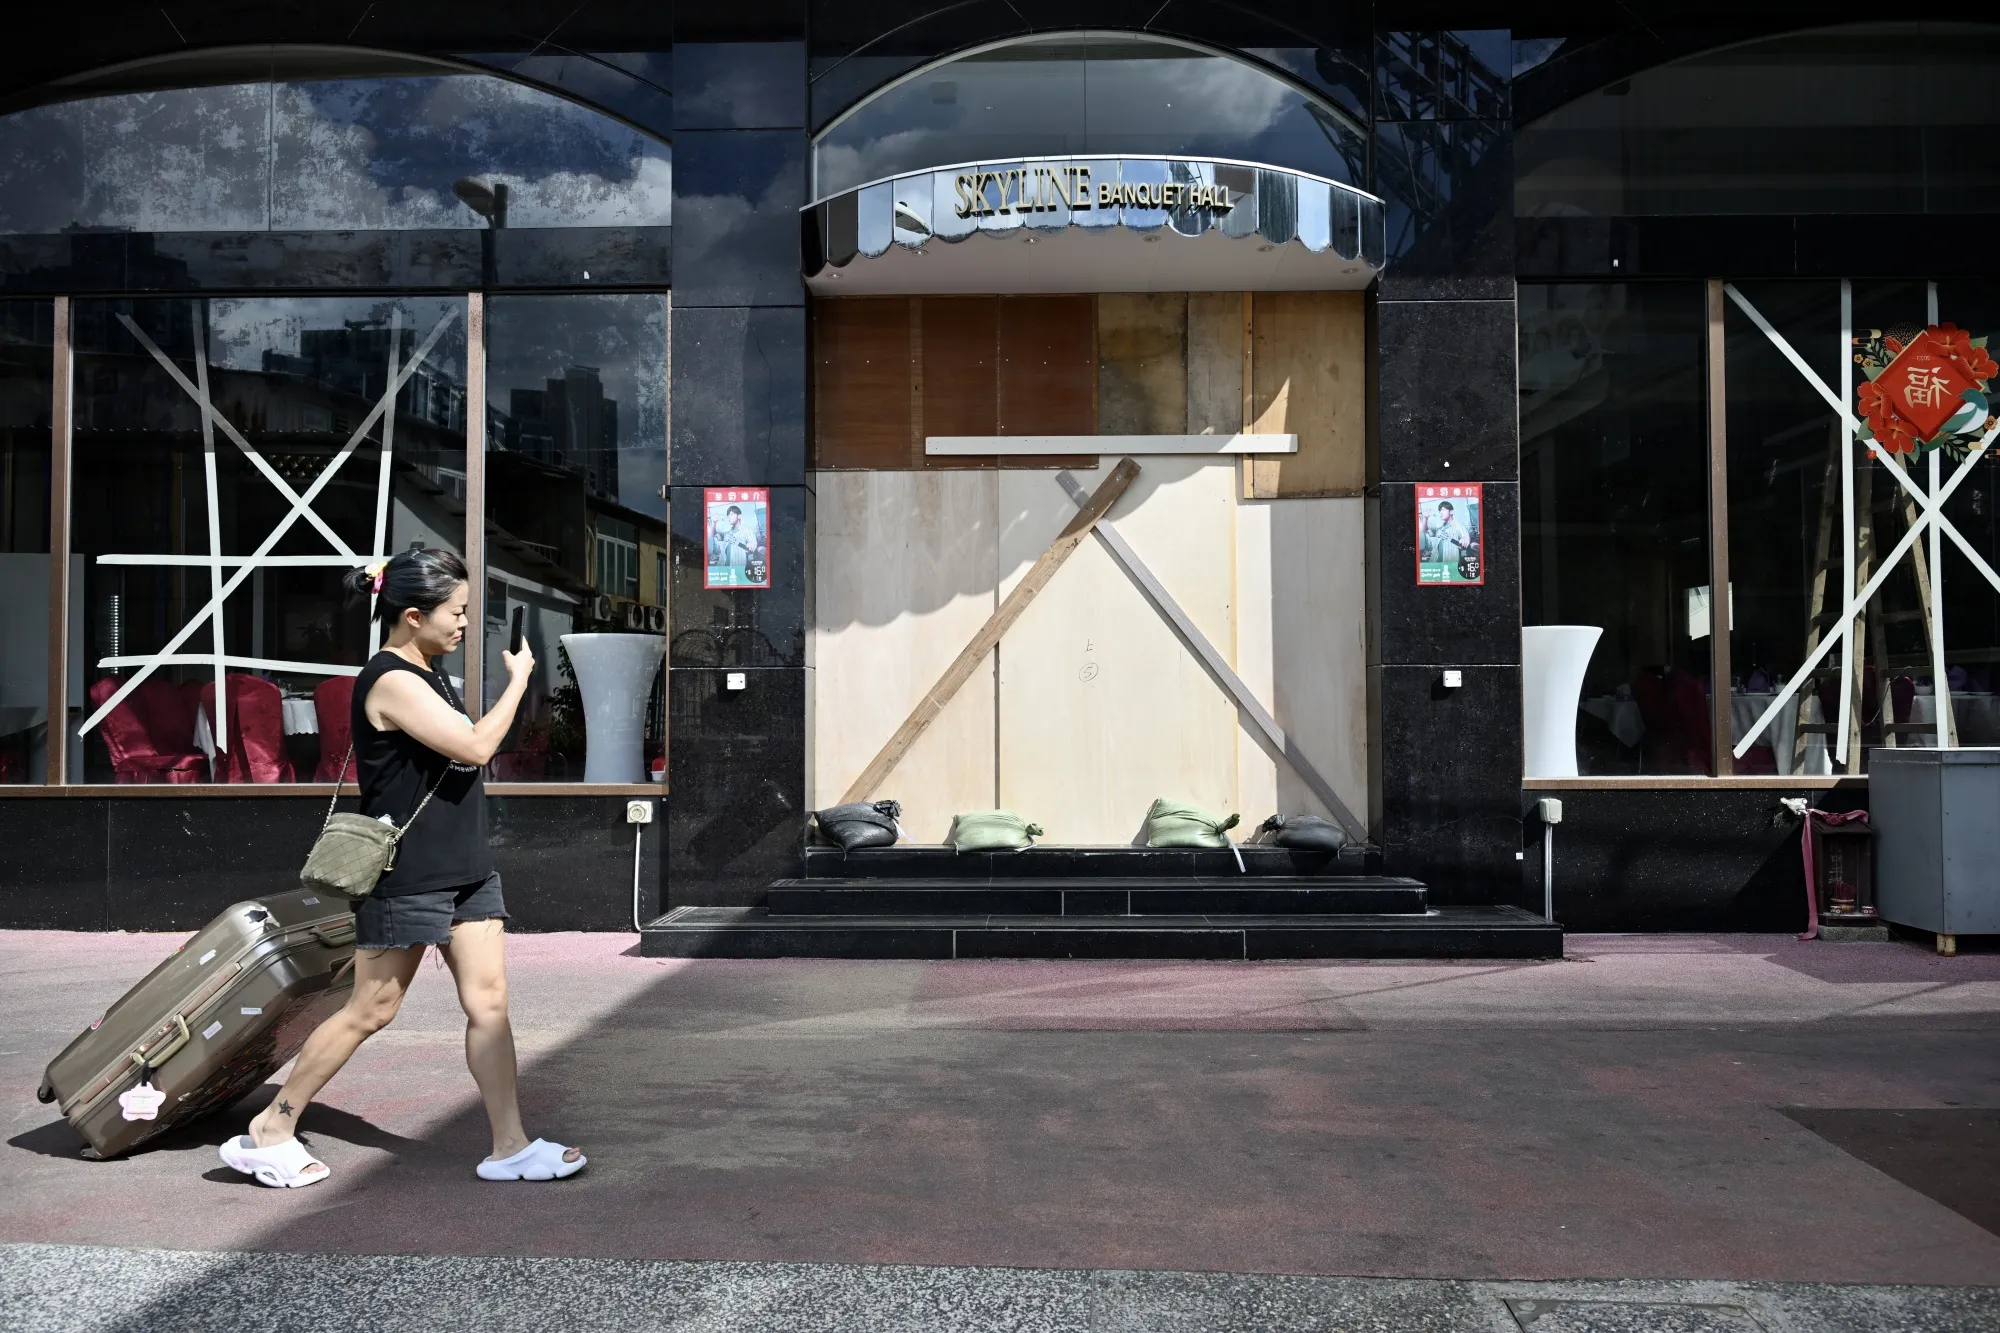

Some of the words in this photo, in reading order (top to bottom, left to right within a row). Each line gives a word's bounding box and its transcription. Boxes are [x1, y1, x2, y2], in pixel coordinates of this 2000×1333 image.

[955, 166, 1092, 219] SKYLINE
[1098, 182, 1185, 208] BANQUET
[1190, 184, 1236, 212] HALL
